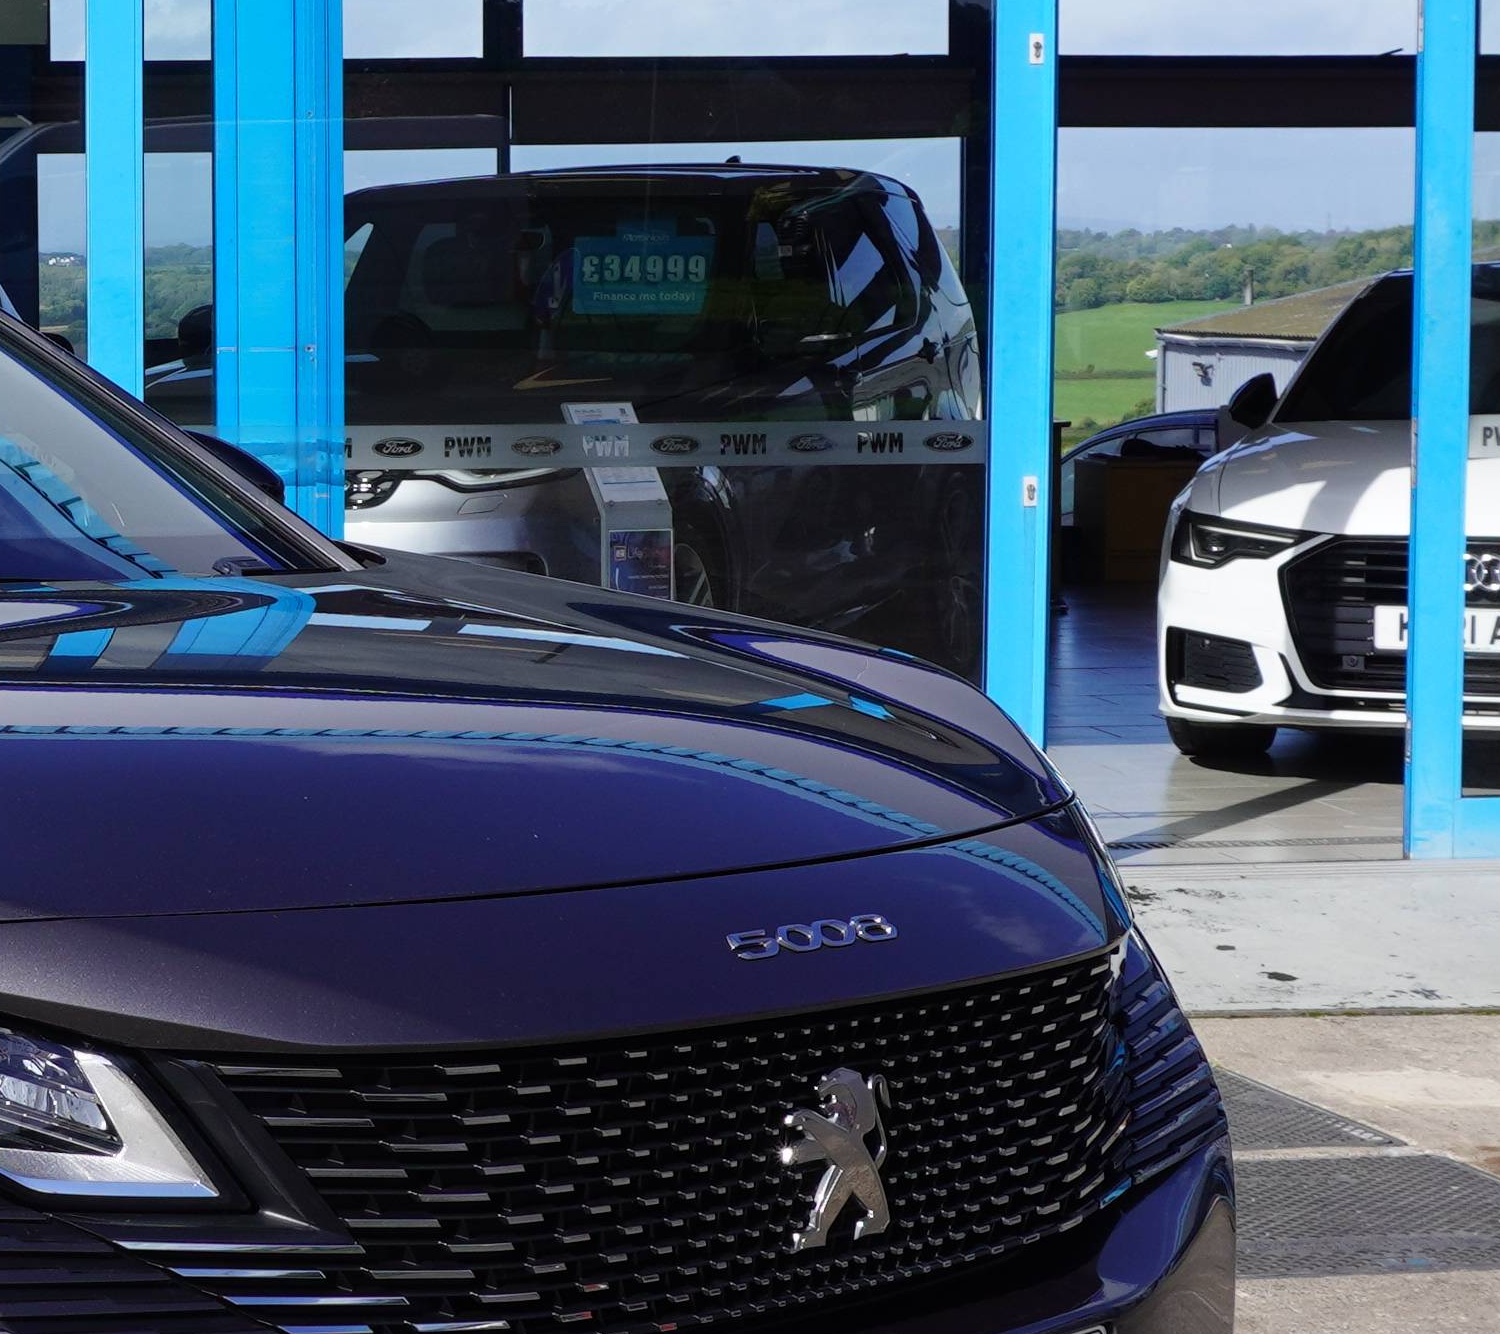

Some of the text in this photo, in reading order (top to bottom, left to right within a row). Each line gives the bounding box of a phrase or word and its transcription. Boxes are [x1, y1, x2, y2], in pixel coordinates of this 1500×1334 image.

[582, 254, 706, 283] £34999
[593, 292, 636, 301] Finance
[444, 436, 492, 457] PWM
[720, 433, 767, 455] PWM
[856, 432, 904, 453] PWM
[726, 913, 898, 961] 5008
